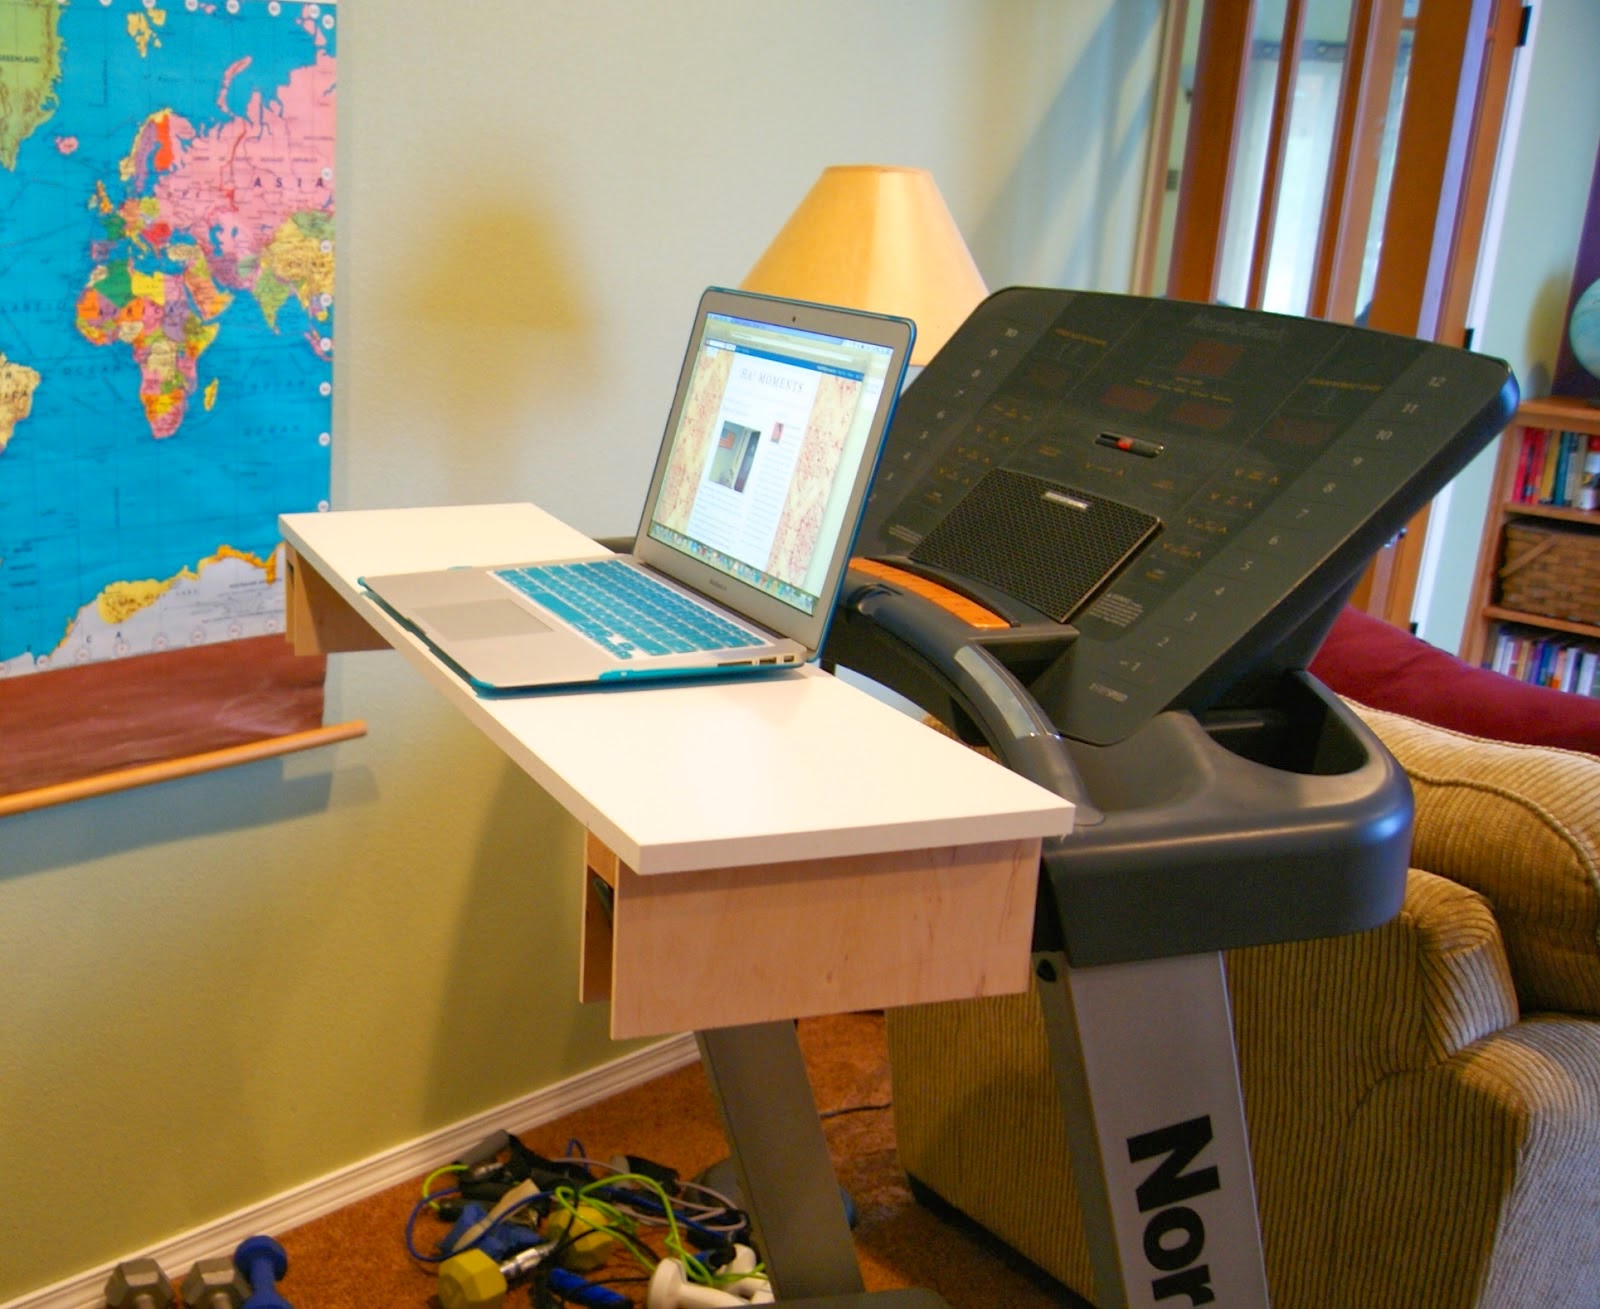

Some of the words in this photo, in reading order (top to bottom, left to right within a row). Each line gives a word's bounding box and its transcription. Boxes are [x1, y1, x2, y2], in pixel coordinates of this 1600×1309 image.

[253, 176, 325, 188] ASIA
[1375, 429, 1393, 441] 10
[1350, 456, 1364, 467] 9
[1322, 482, 1336, 494] 8
[1295, 508, 1310, 519] 7
[1239, 560, 1254, 571] 5
[1126, 1114, 1222, 1307] Nor
